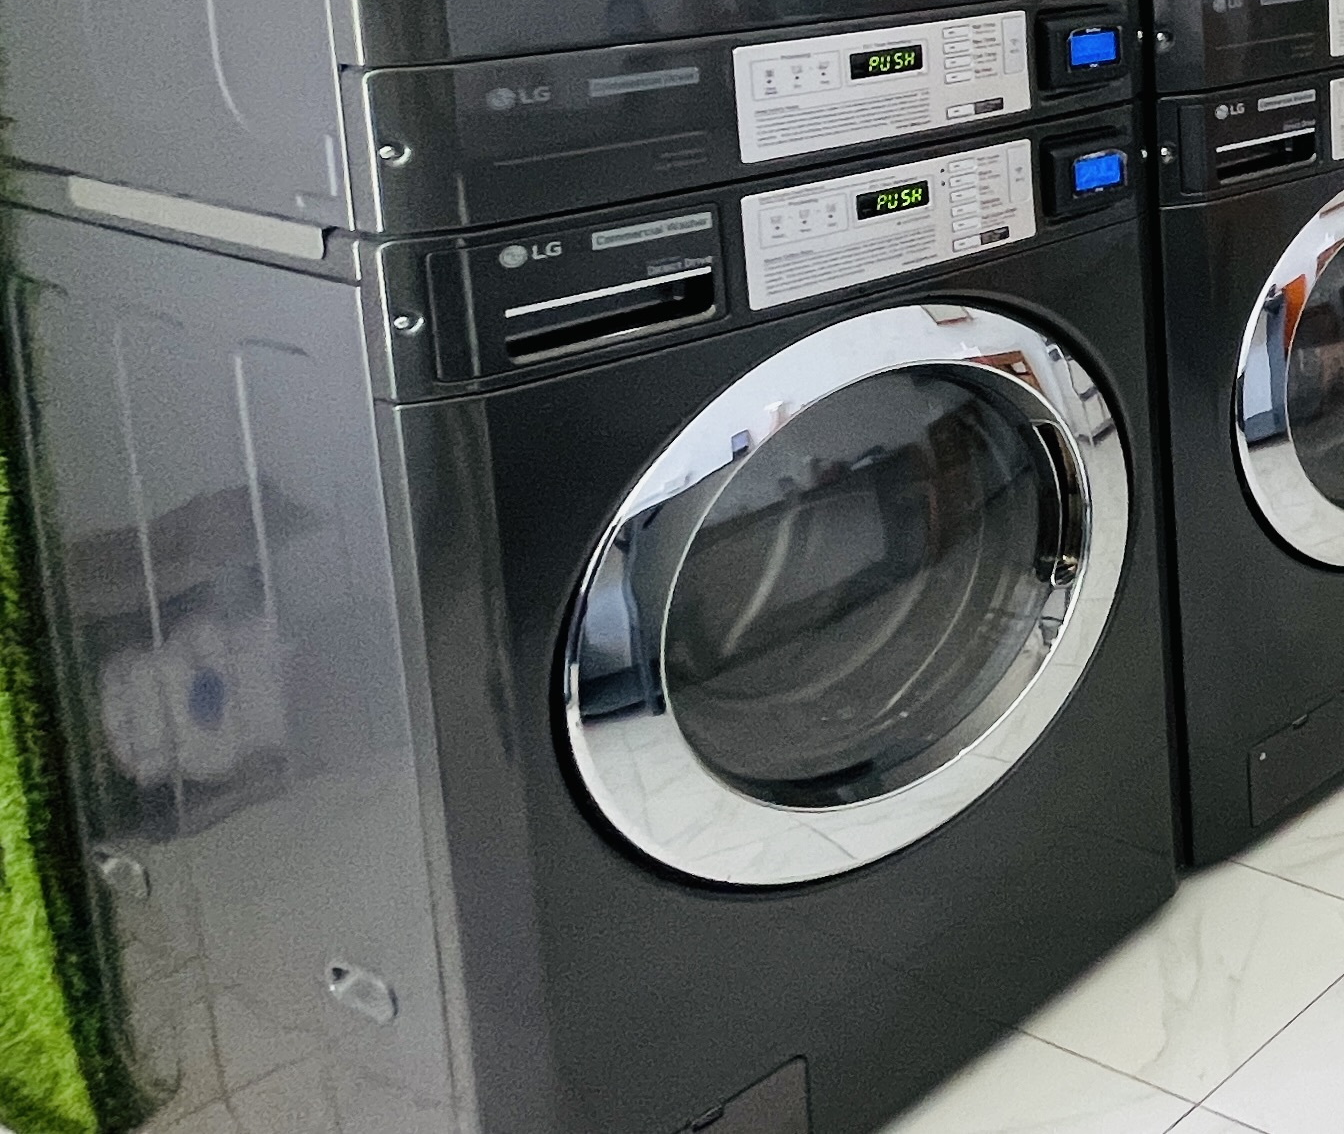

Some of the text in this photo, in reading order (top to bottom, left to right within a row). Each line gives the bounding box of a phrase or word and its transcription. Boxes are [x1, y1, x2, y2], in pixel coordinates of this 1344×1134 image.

[868, 52, 916, 72] PUSH
[518, 86, 551, 105] LG
[1230, 102, 1246, 116] LG
[876, 187, 923, 210] PUSH
[531, 241, 562, 260] LG
